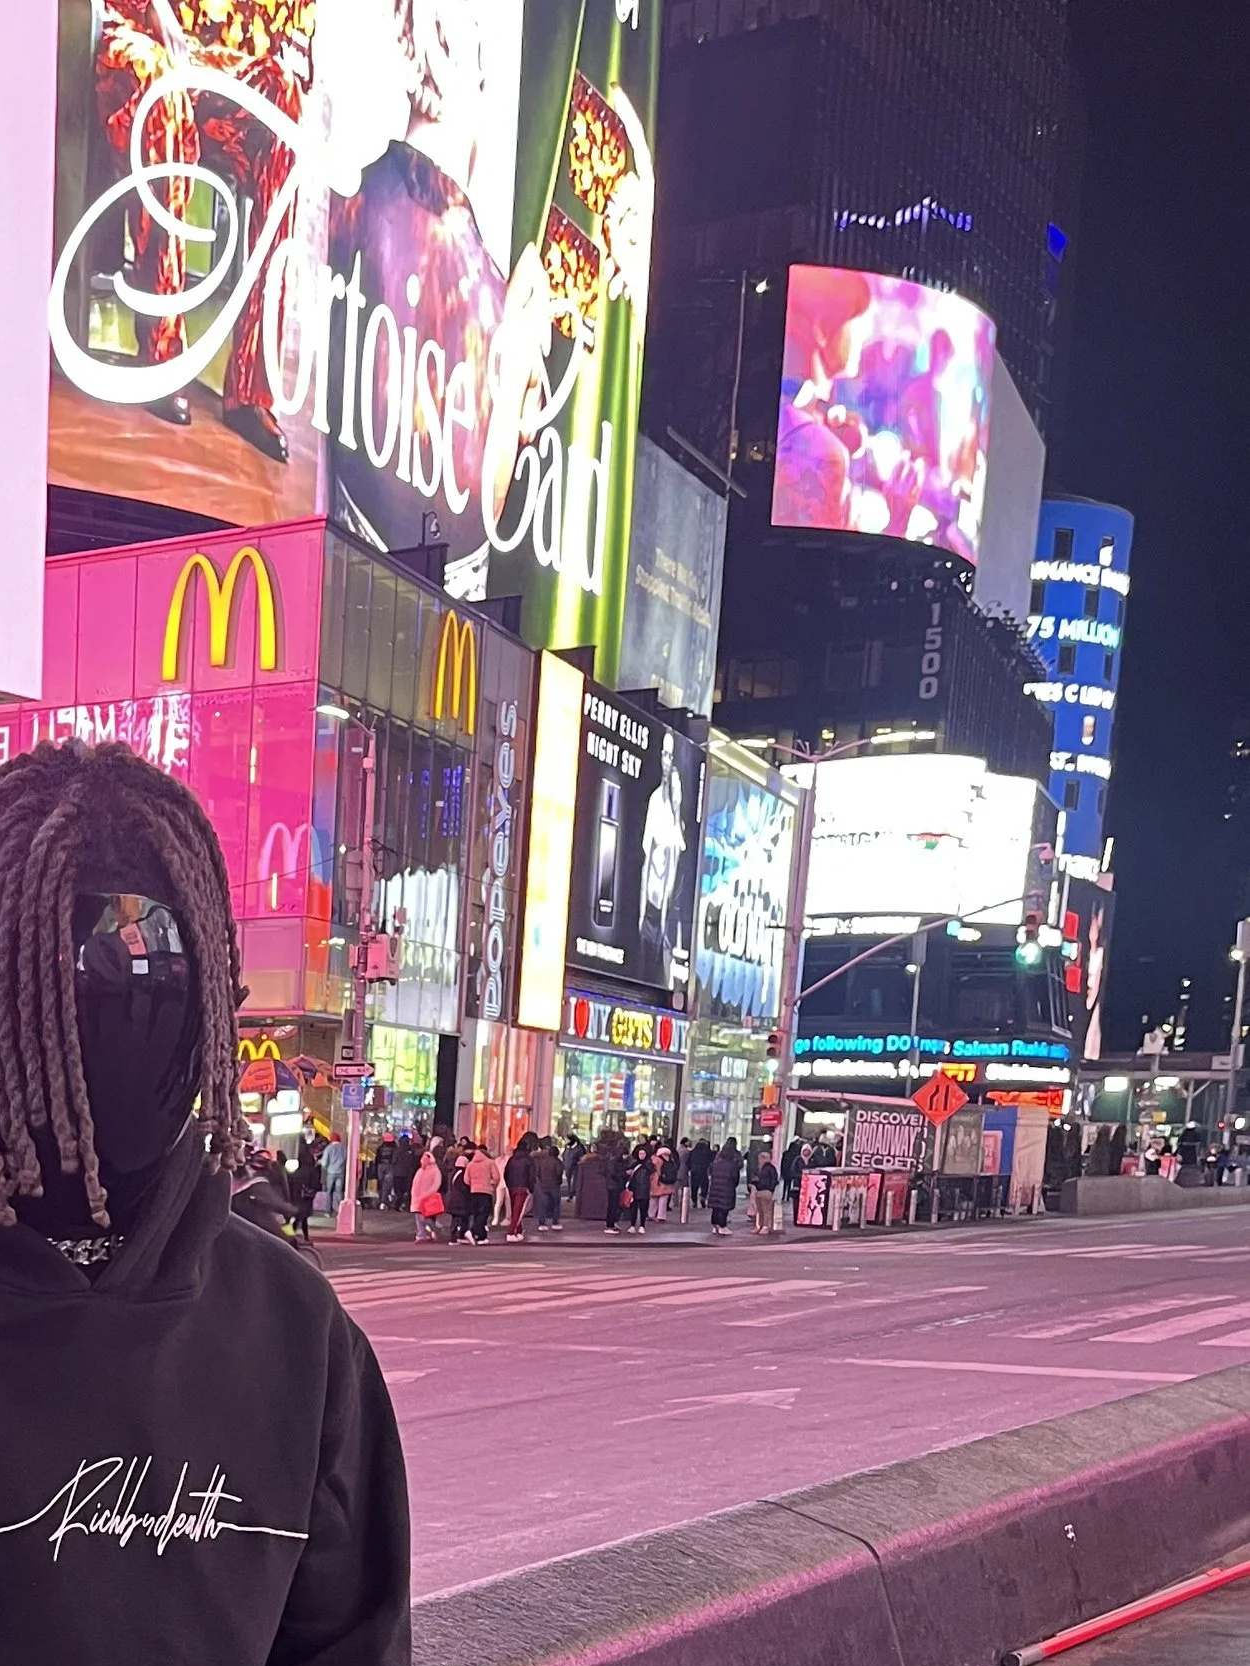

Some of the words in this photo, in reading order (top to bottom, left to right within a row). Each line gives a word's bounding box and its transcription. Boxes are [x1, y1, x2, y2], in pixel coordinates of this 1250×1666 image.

[583, 692, 619, 732] PERRY
[619, 714, 650, 750] ELLIS
[586, 731, 620, 768] NIGHT
[621, 750, 642, 779] SKY
[812, 1035, 884, 1054] following
[952, 1040, 1010, 1057] Salman
